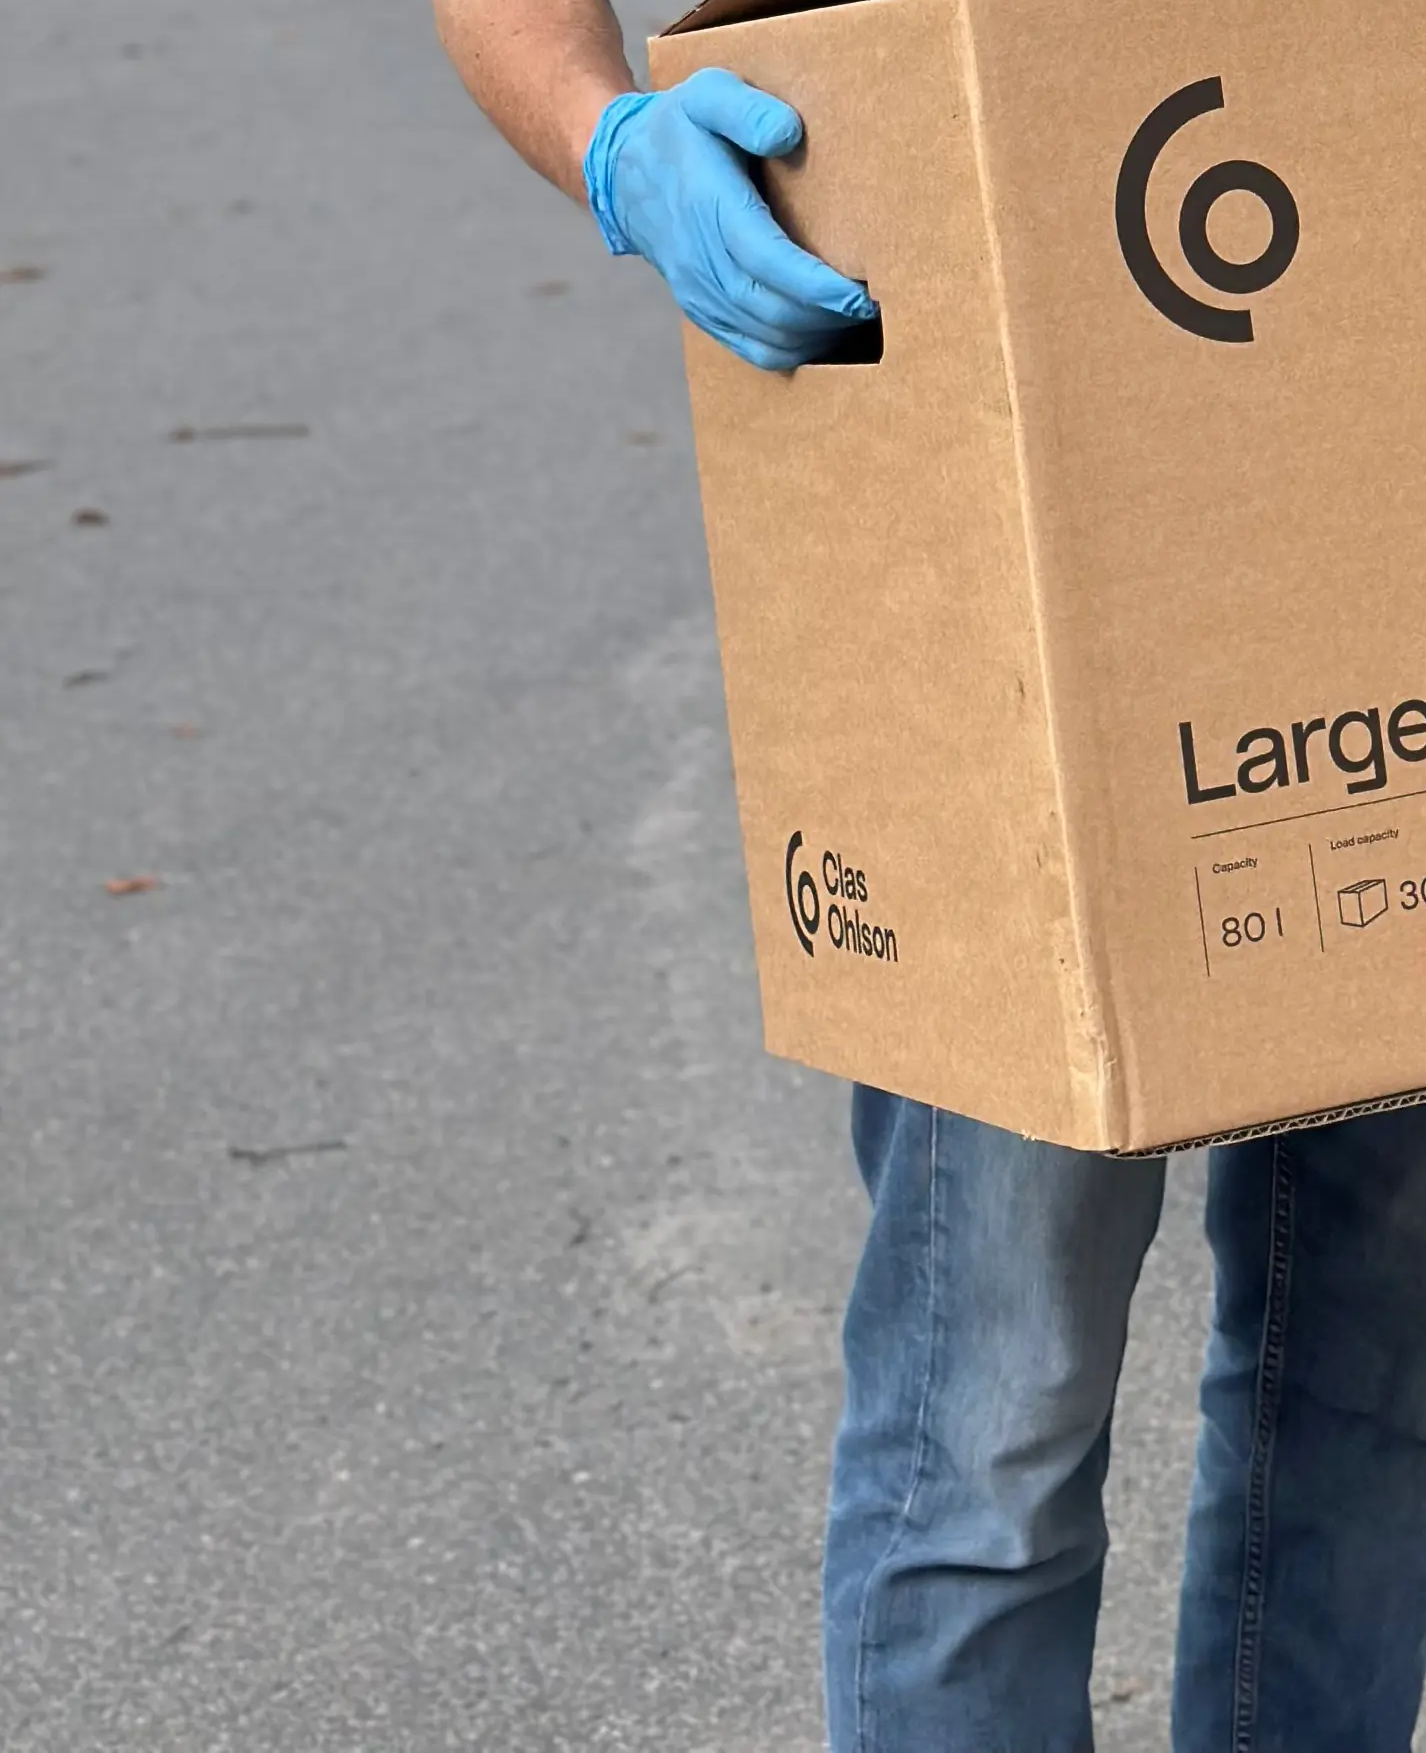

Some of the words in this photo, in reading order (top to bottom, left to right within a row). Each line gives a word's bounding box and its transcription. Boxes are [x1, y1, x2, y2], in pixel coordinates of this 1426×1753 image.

[1330, 835, 1355, 850] Load
[1356, 828, 1399, 845] capacity
[822, 850, 868, 902] Clas
[1211, 857, 1258, 874] Capacity
[828, 903, 898, 962] Ohlson
[1221, 913, 1266, 947] 80
